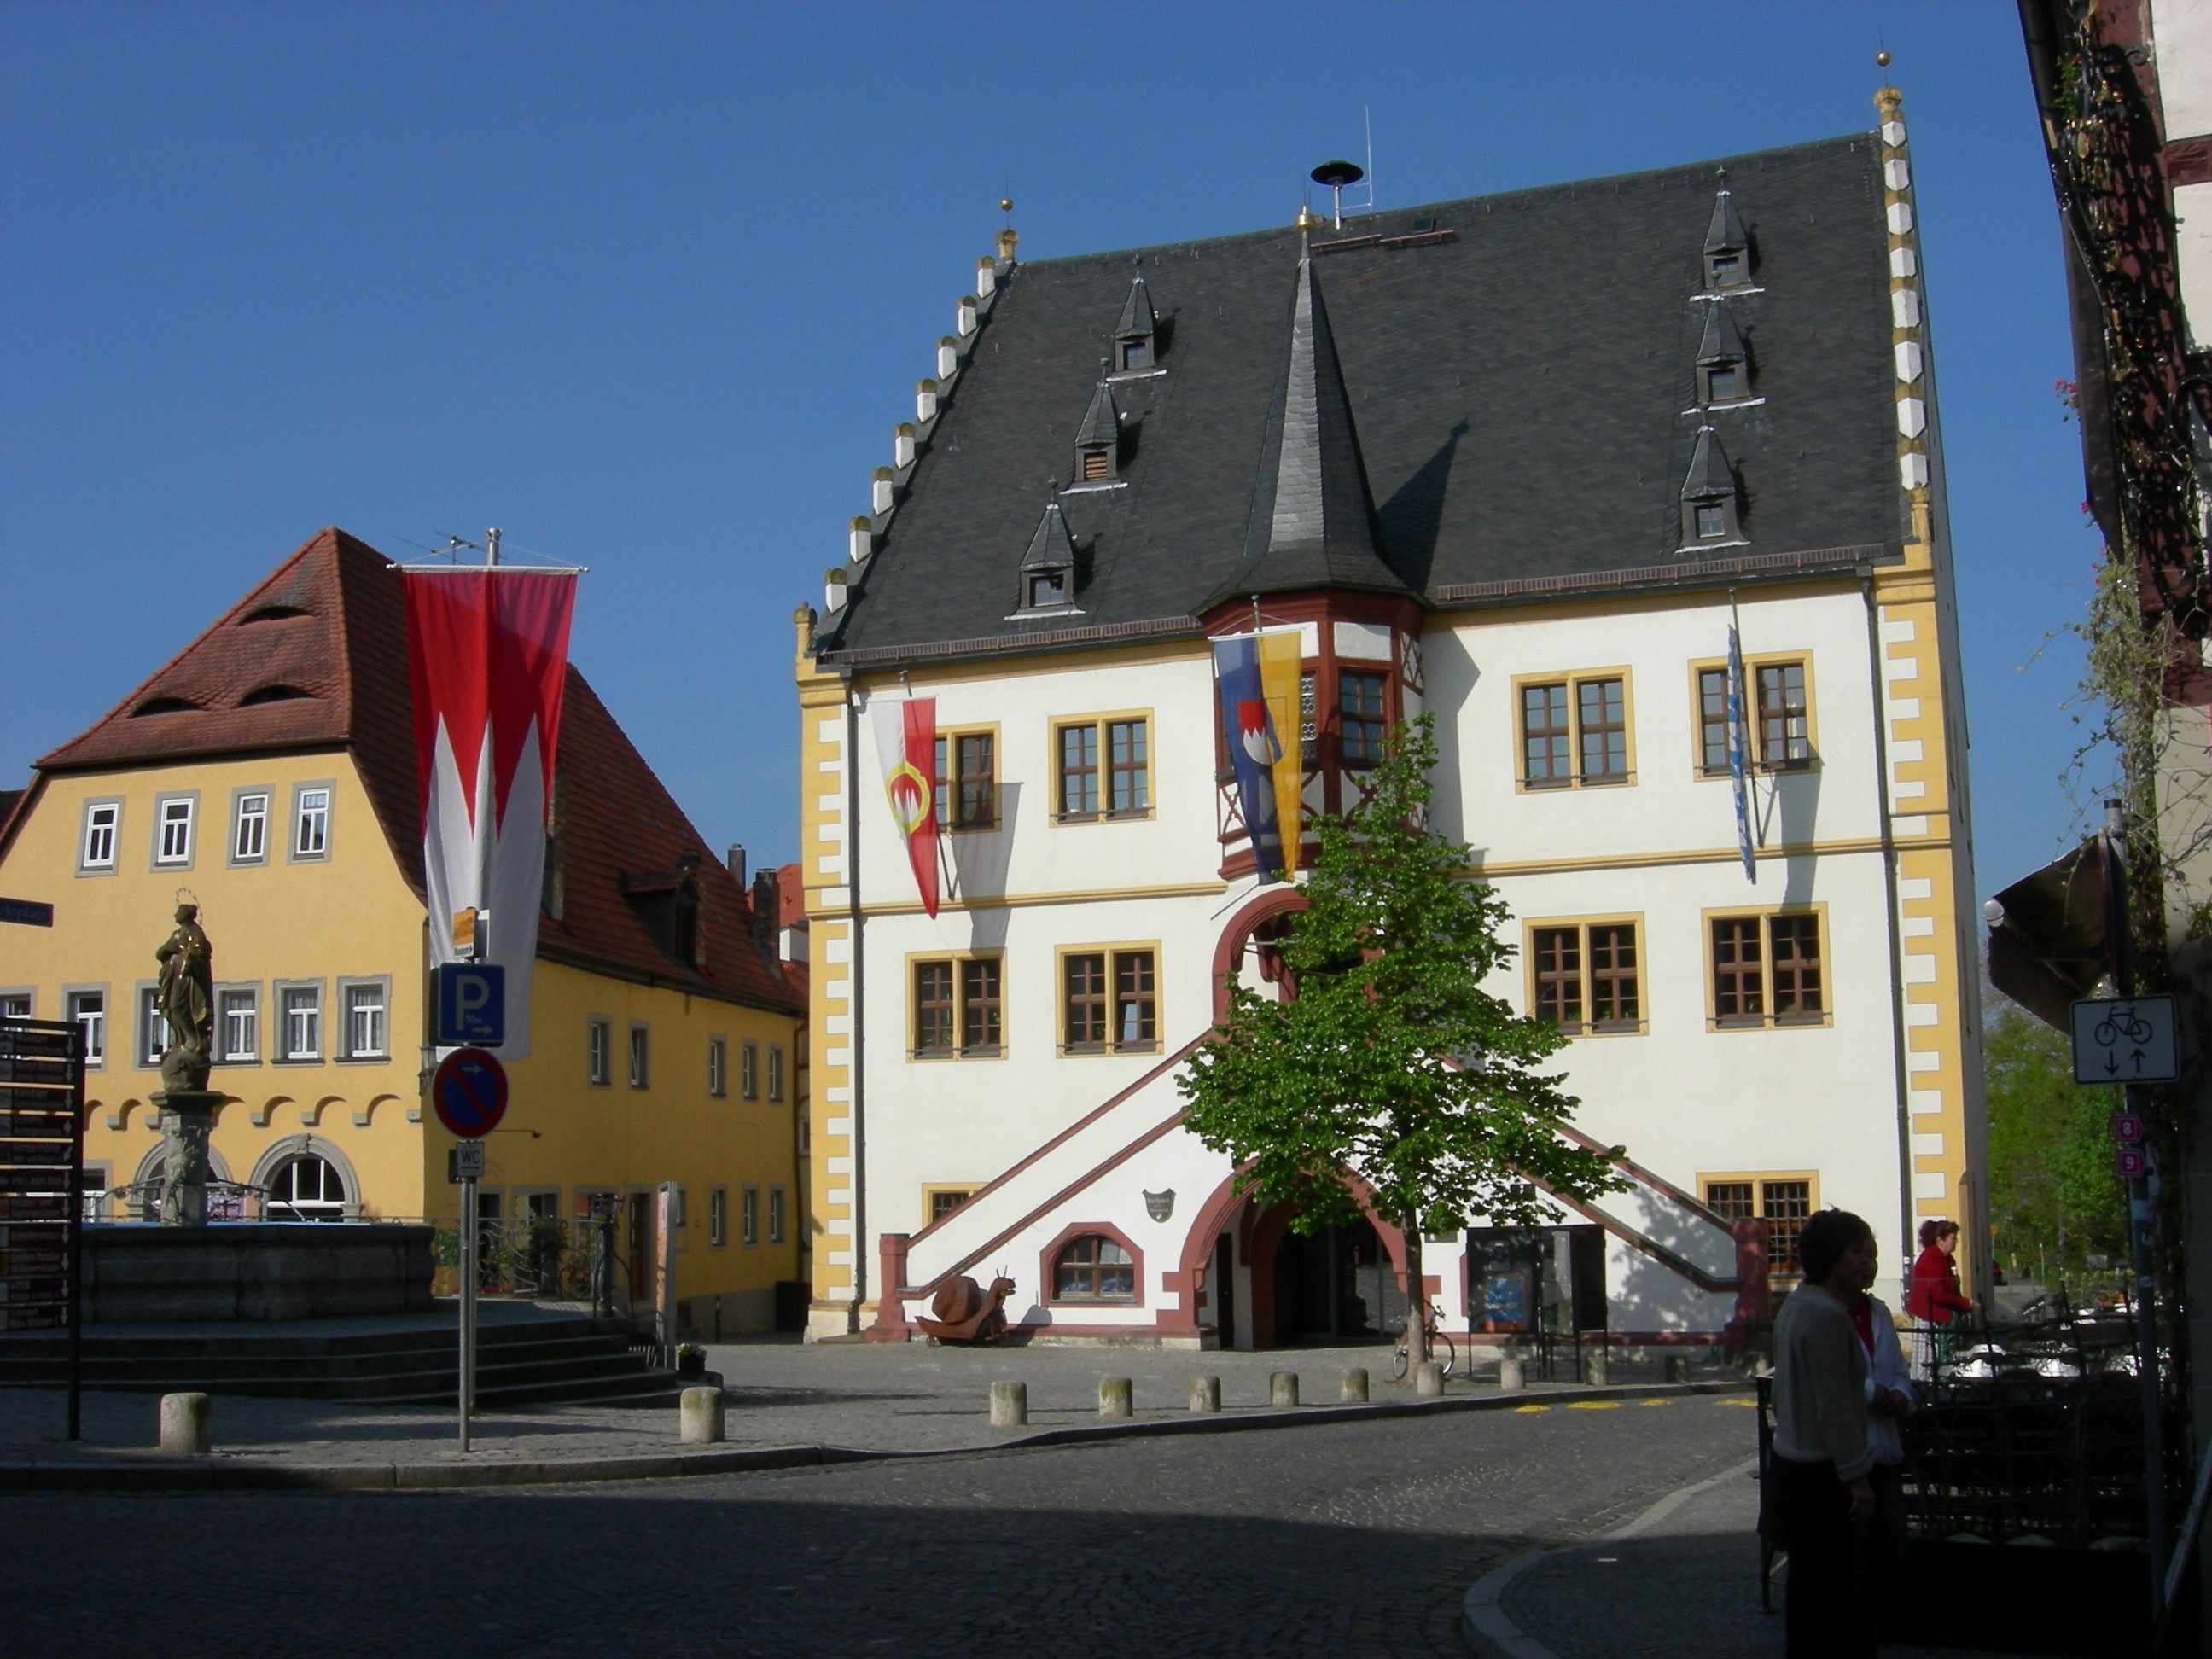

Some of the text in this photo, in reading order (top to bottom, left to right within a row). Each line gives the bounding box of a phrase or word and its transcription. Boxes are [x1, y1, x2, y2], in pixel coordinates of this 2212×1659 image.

[457, 975, 490, 1031] P
[465, 1014, 482, 1024] 50m
[2122, 1122, 2131, 1134] 8
[461, 1150, 480, 1163] WC
[2126, 1156, 2133, 1168] 9
